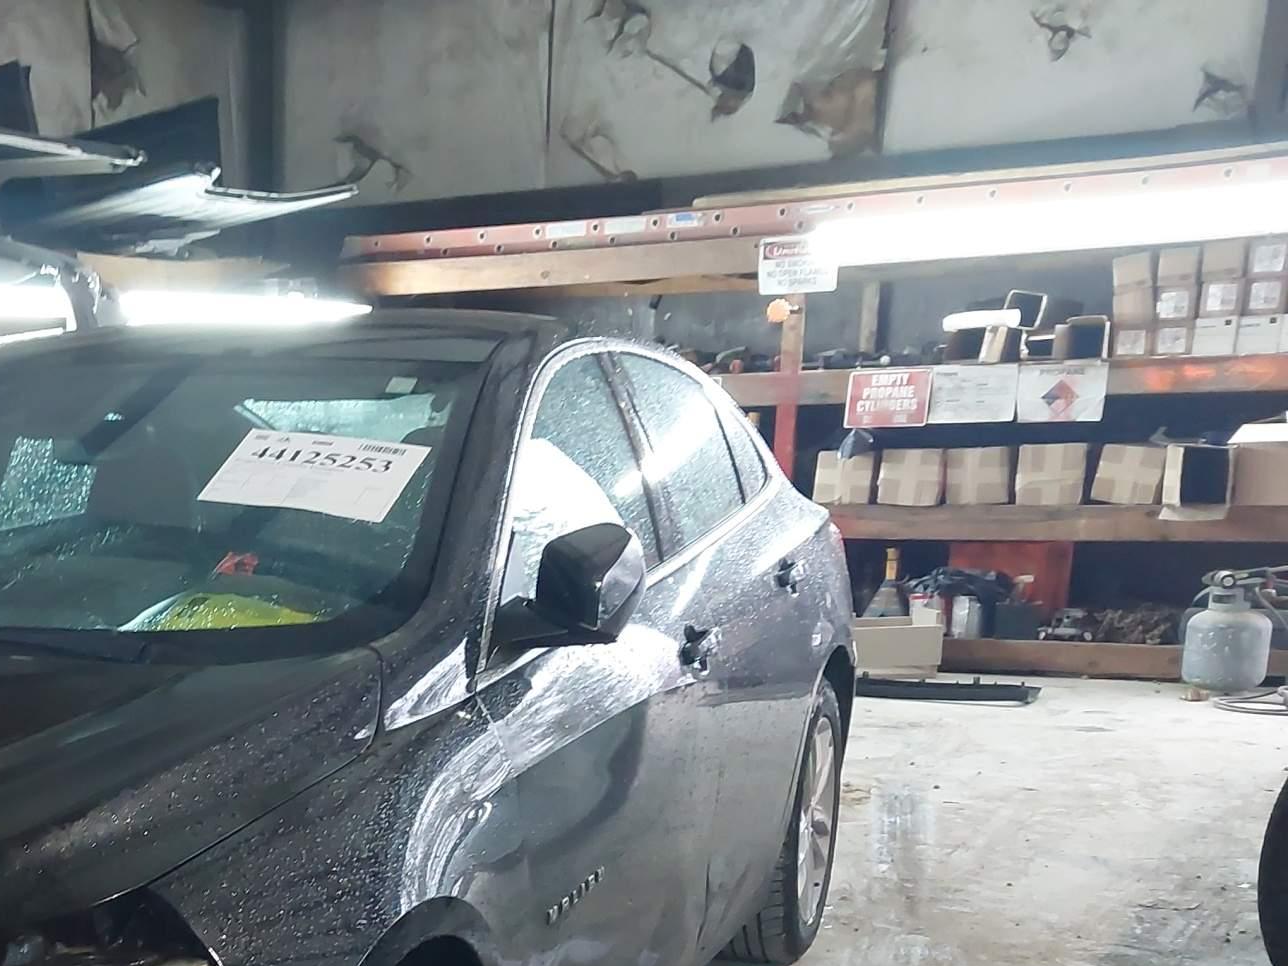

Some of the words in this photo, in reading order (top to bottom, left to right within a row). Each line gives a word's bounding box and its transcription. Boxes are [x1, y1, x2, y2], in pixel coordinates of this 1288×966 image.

[872, 373, 910, 386] EMPTY
[863, 385, 916, 400] PROPANE
[251, 445, 394, 473] 44125253
[545, 866, 606, 926] MALIBU
